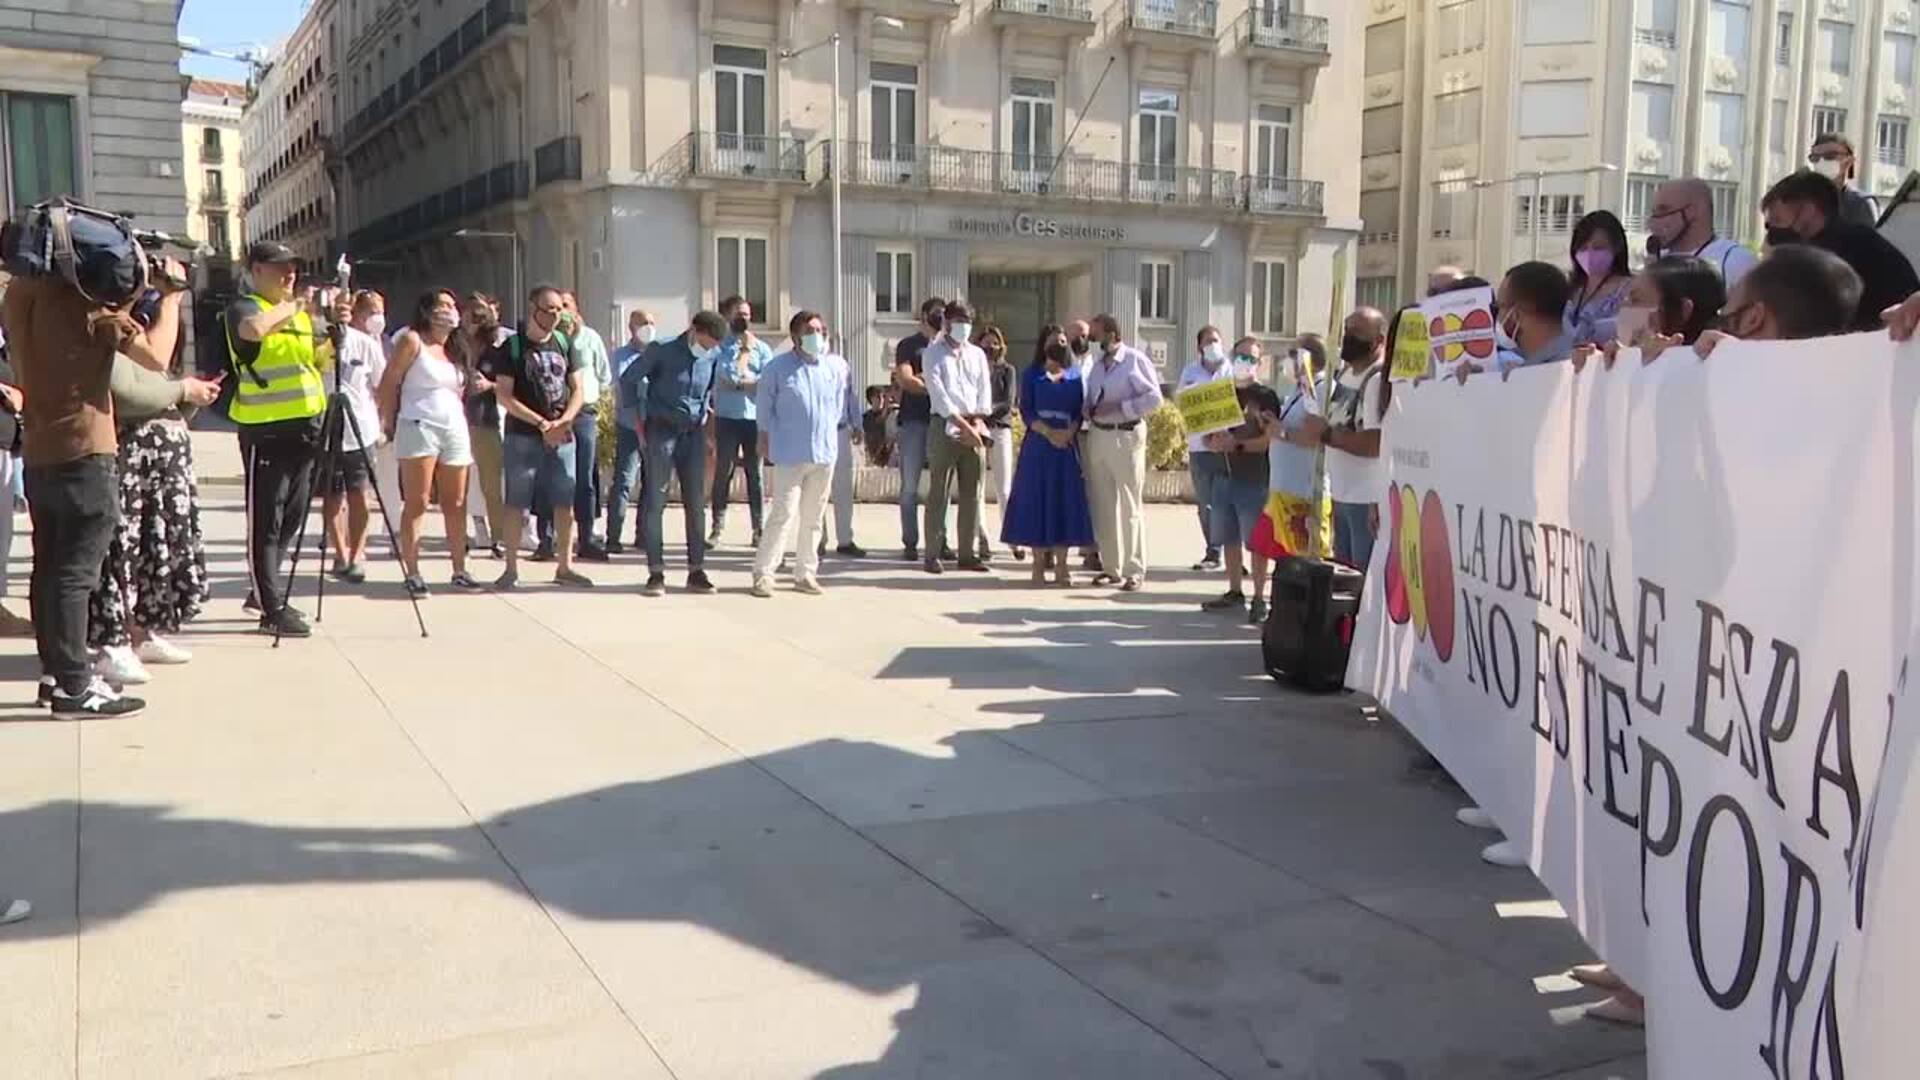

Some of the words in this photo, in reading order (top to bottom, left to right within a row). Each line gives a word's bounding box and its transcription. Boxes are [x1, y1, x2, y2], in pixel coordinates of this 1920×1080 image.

[1014, 212, 1058, 237] Ges
[1456, 503, 1488, 584] LA
[1461, 587, 1521, 709] NO
